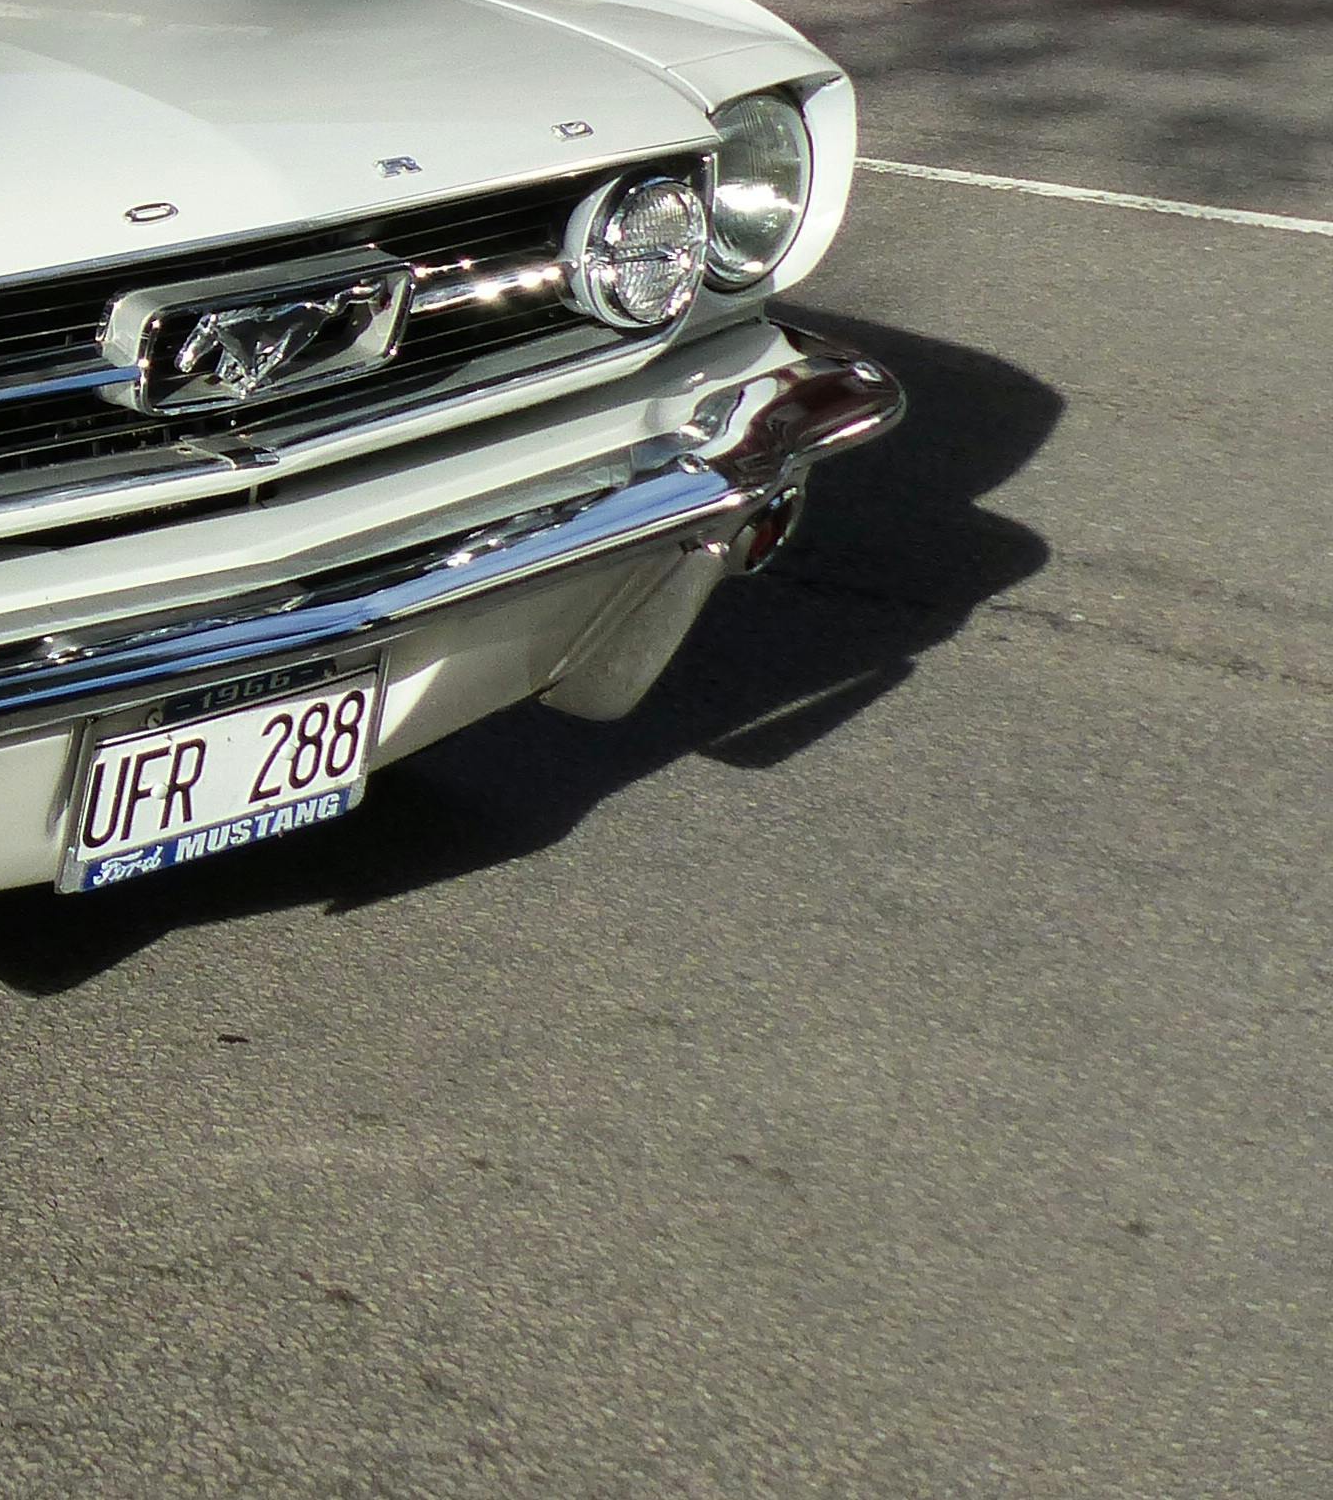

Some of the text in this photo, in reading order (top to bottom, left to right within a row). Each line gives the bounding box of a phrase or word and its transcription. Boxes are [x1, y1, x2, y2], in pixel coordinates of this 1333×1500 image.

[82, 689, 366, 849] UFR 288
[93, 792, 341, 886] Ford MUSTANG
